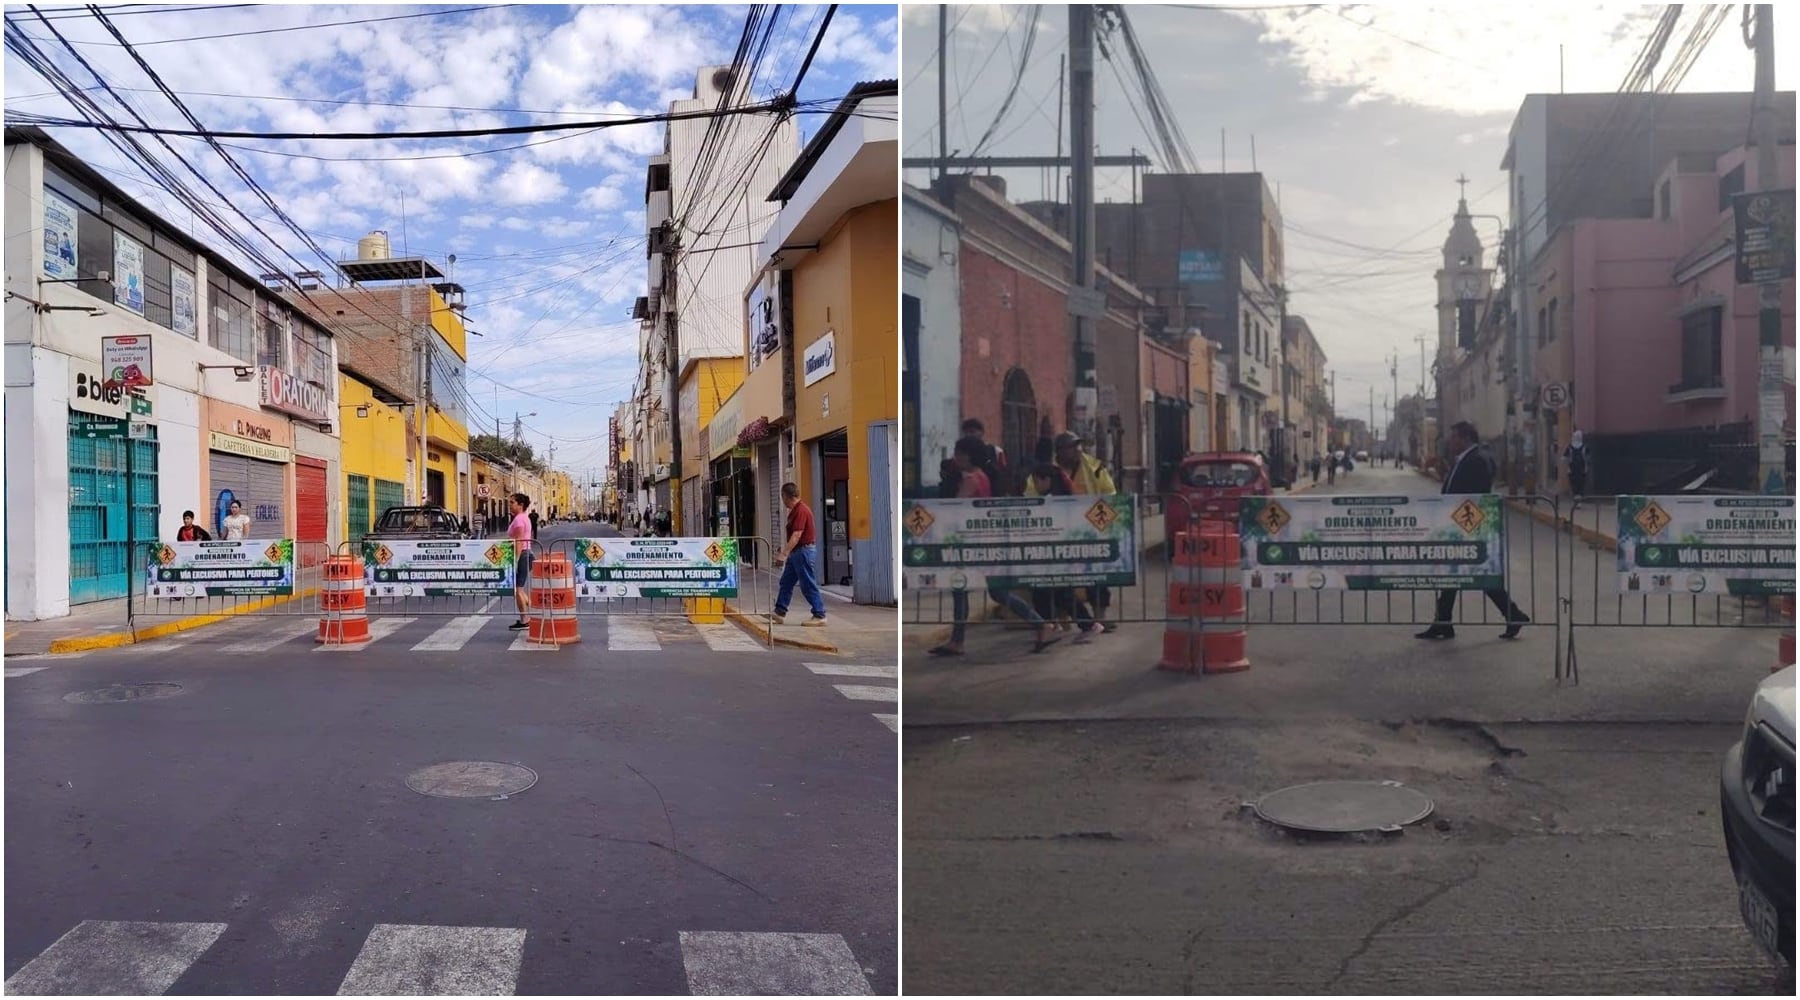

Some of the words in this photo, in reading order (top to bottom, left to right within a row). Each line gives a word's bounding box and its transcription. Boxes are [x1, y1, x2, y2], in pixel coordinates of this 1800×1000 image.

[260, 366, 268, 404] BALLET
[271, 369, 328, 417] ORATORIA
[237, 419, 244, 436] EL
[966, 517, 1053, 530] ORDENAMIENTO
[1324, 516, 1417, 528] ORDENAMIENTO
[962, 546, 1021, 562] EXCLUSIVA
[1023, 545, 1053, 560] PARA
[1055, 543, 1111, 559] PEATONES
[1298, 545, 1319, 561] VÍA
[1321, 545, 1384, 561] EXCLUSIVA
[1385, 545, 1419, 561] PARA
[1419, 544, 1478, 560] PEATONES
[1678, 546, 1699, 563] VÍA
[1701, 548, 1768, 563] EXCLUSIVA
[1769, 549, 1796, 563] PAR
[180, 569, 191, 580] VÍA
[192, 570, 227, 579] EXCLUSIVA
[228, 570, 246, 579] PARA
[247, 569, 279, 578] PEATONES
[326, 564, 348, 576] MPI
[397, 570, 409, 580] VÍA
[410, 571, 447, 580] EXCLUSIVA
[447, 571, 465, 580] PARA
[466, 571, 500, 580] PEATONES
[610, 569, 622, 579] VÍA
[623, 570, 664, 579] EXCLUSIVA
[664, 570, 684, 579] PARA
[684, 569, 721, 579] PEATONES
